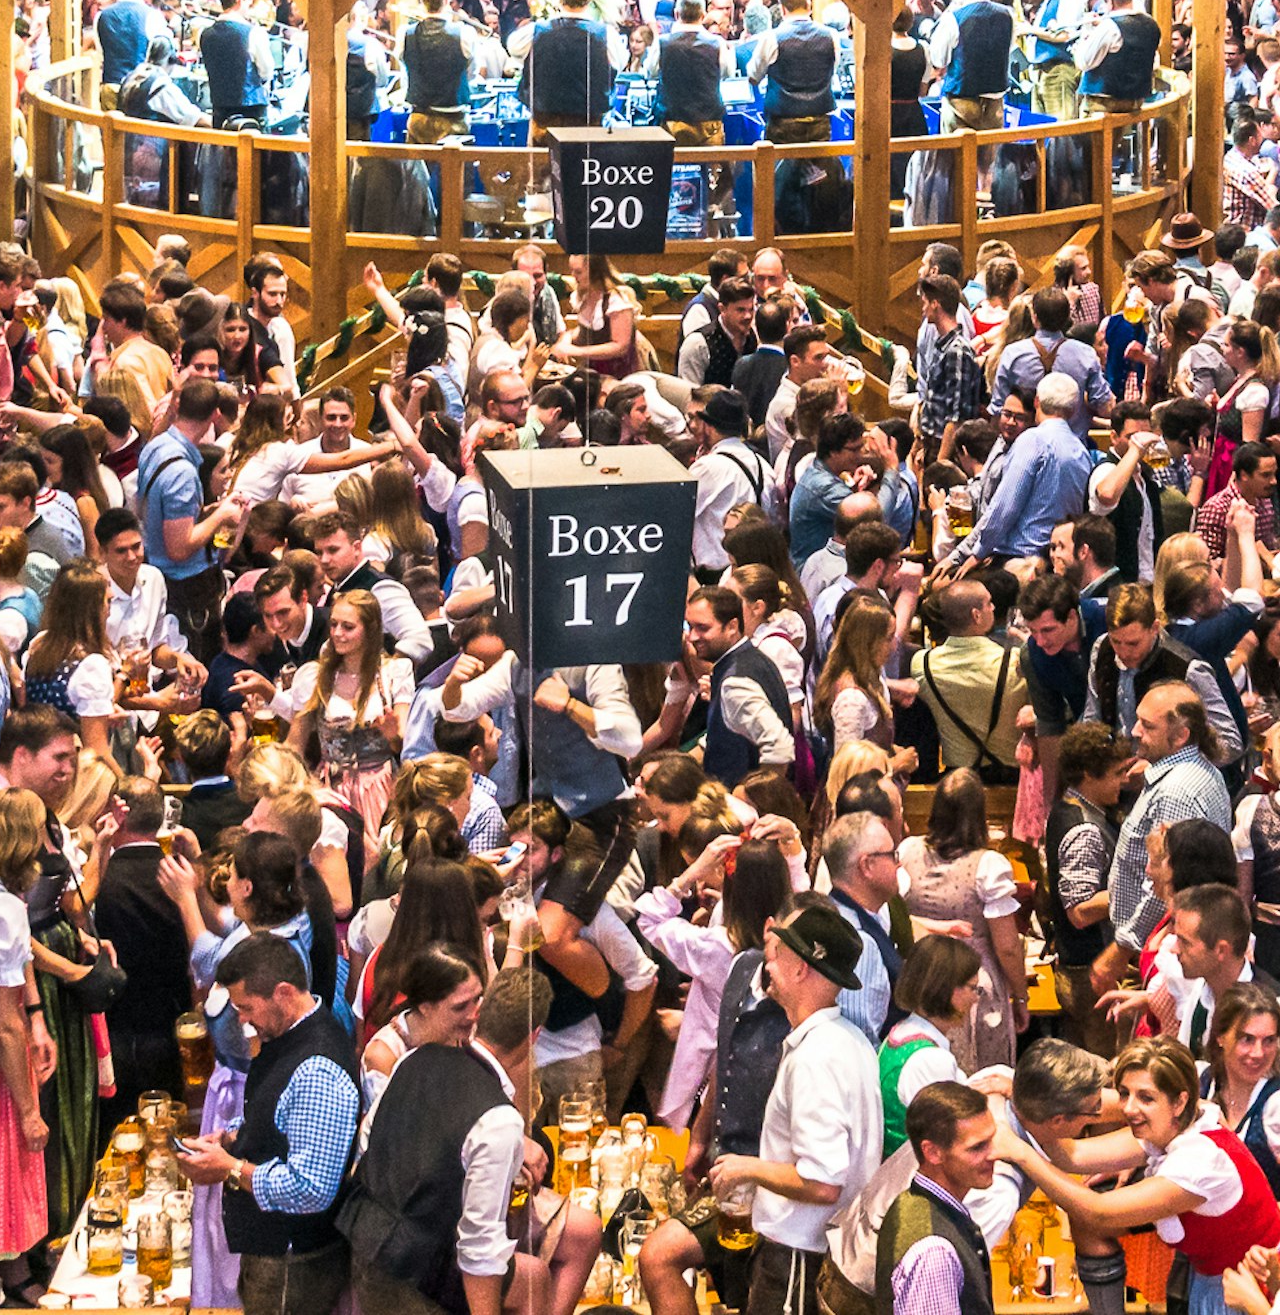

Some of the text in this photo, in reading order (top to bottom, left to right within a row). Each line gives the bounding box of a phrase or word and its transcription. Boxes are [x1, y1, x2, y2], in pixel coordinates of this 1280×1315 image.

[581, 158, 654, 186] Boxe
[589, 195, 644, 230] 20
[547, 514, 664, 557] Boxe
[496, 555, 513, 614] 17
[564, 571, 645, 627] 17
